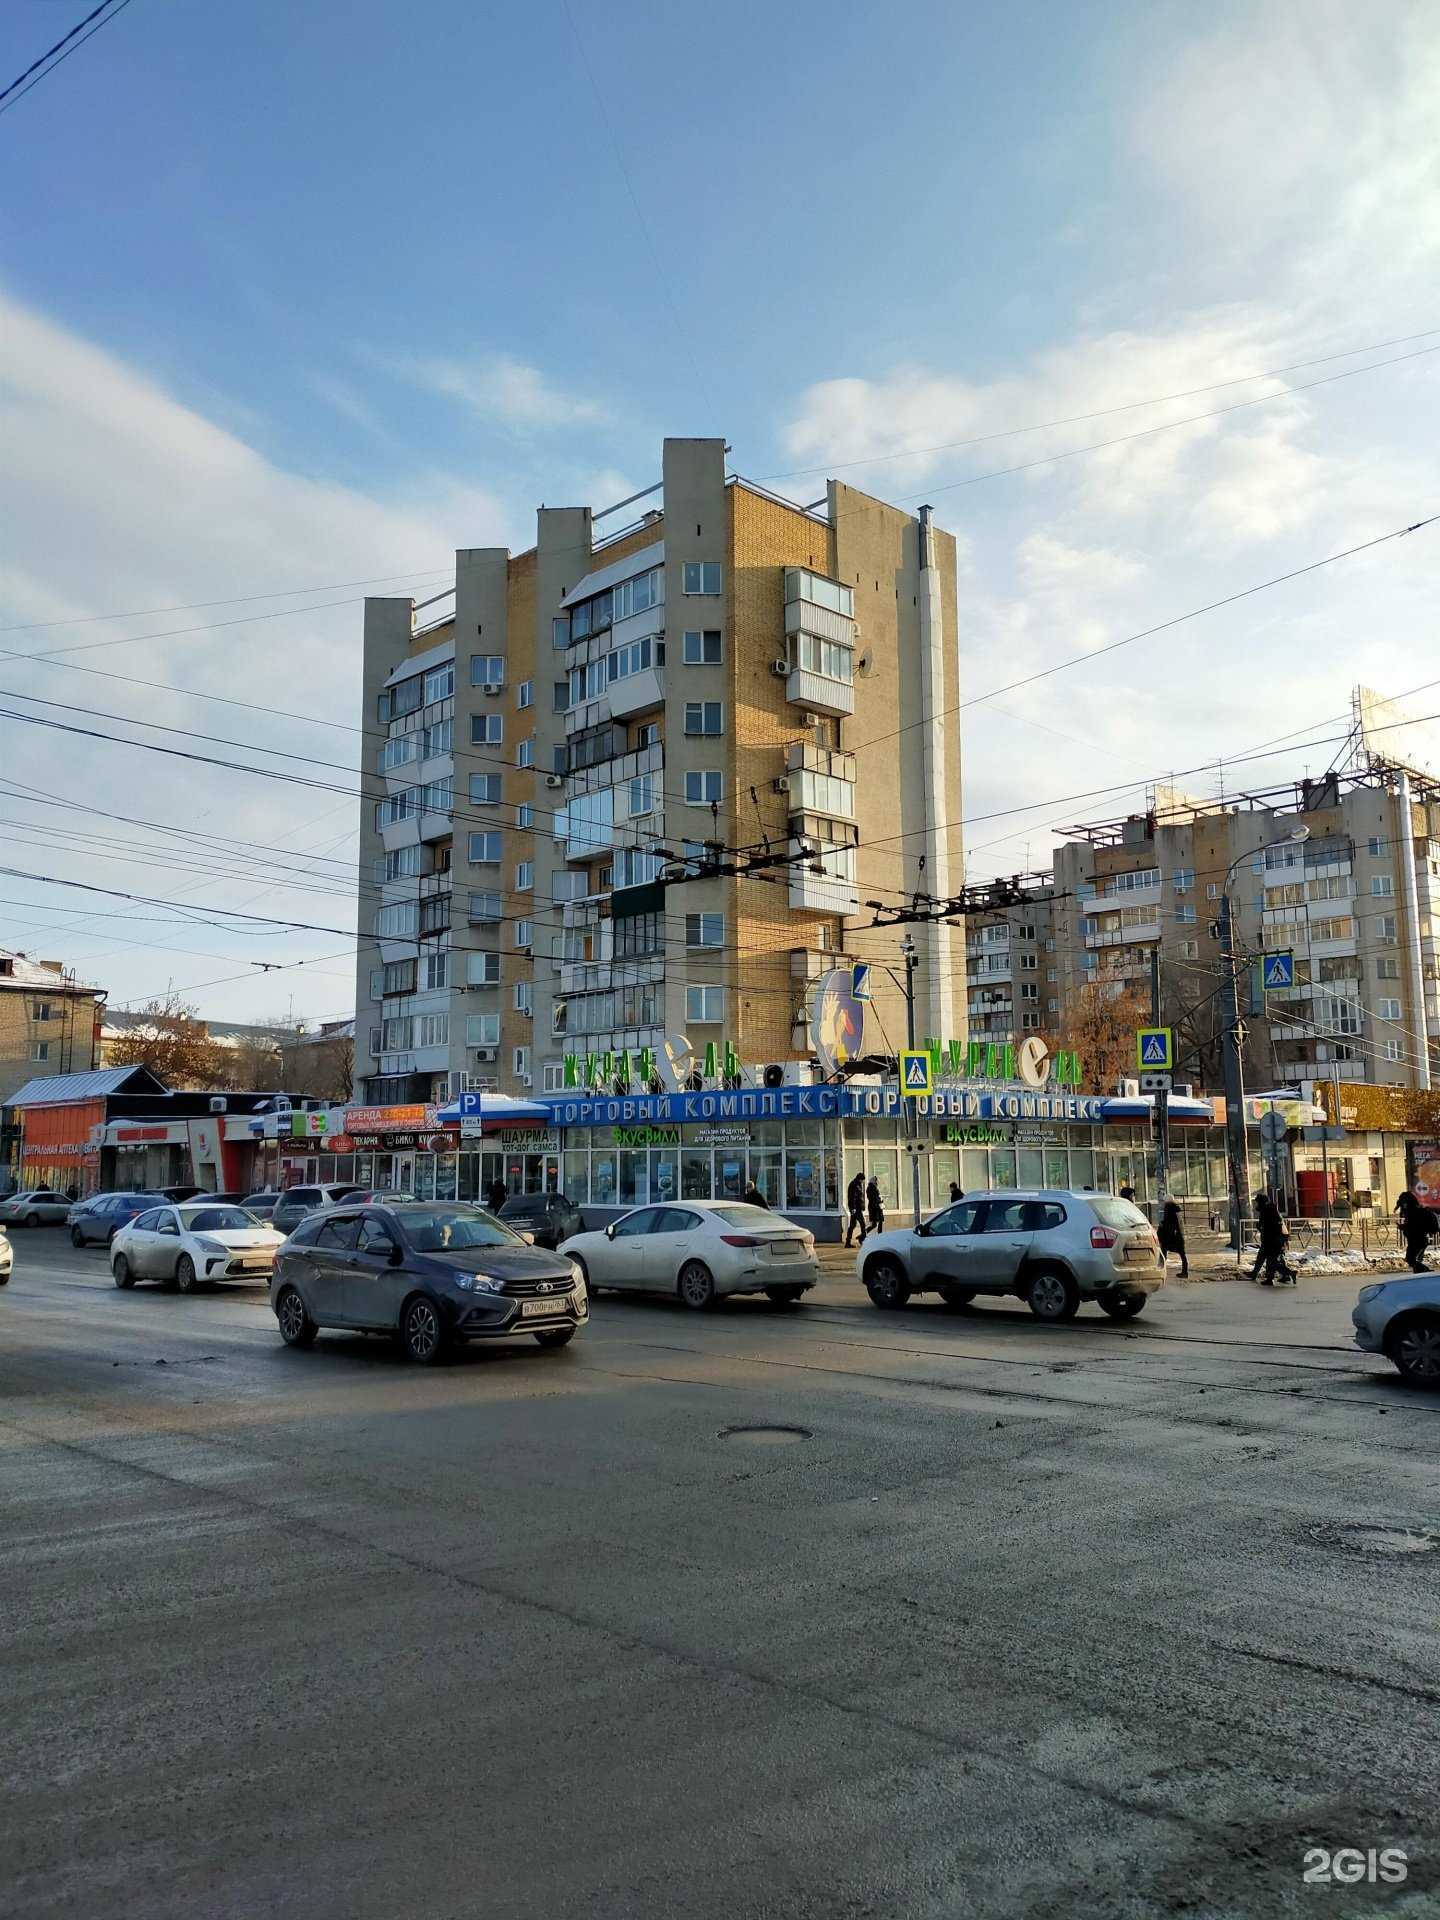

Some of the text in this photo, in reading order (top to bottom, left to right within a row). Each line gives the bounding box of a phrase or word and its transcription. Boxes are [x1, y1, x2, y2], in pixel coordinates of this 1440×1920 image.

[464, 1095, 476, 1113] P
[552, 1089, 835, 1122] ТОРГОВЫЙ КОМПЛЕКС
[852, 1090, 1101, 1119] ТОРОВЫЙ КОМПЛЕКС
[347, 1110, 382, 1121] АРЕНДА
[353, 1136, 378, 1146] ПЕКАРНЯ
[501, 1129, 549, 1144] ШАУРМА
[613, 1127, 678, 1146] ВкусВилл
[946, 1125, 1007, 1143] ВкусВилл
[533, 1142, 557, 1151] самса
